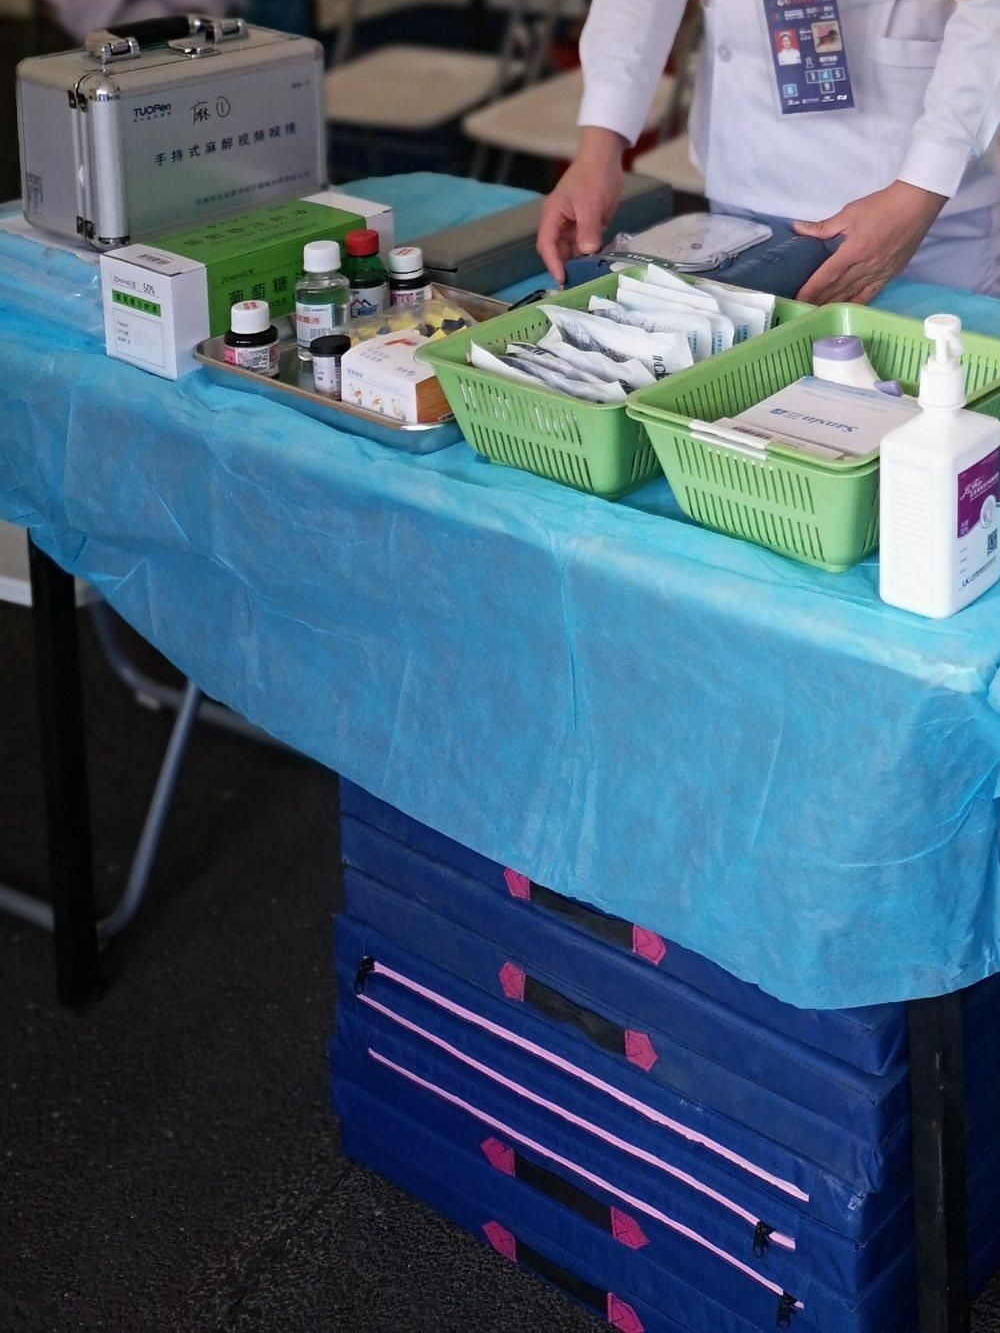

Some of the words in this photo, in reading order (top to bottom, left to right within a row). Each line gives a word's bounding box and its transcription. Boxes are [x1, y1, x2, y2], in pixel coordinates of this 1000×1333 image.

[154, 122, 297, 166] 手持式麻醉视频喉镜
